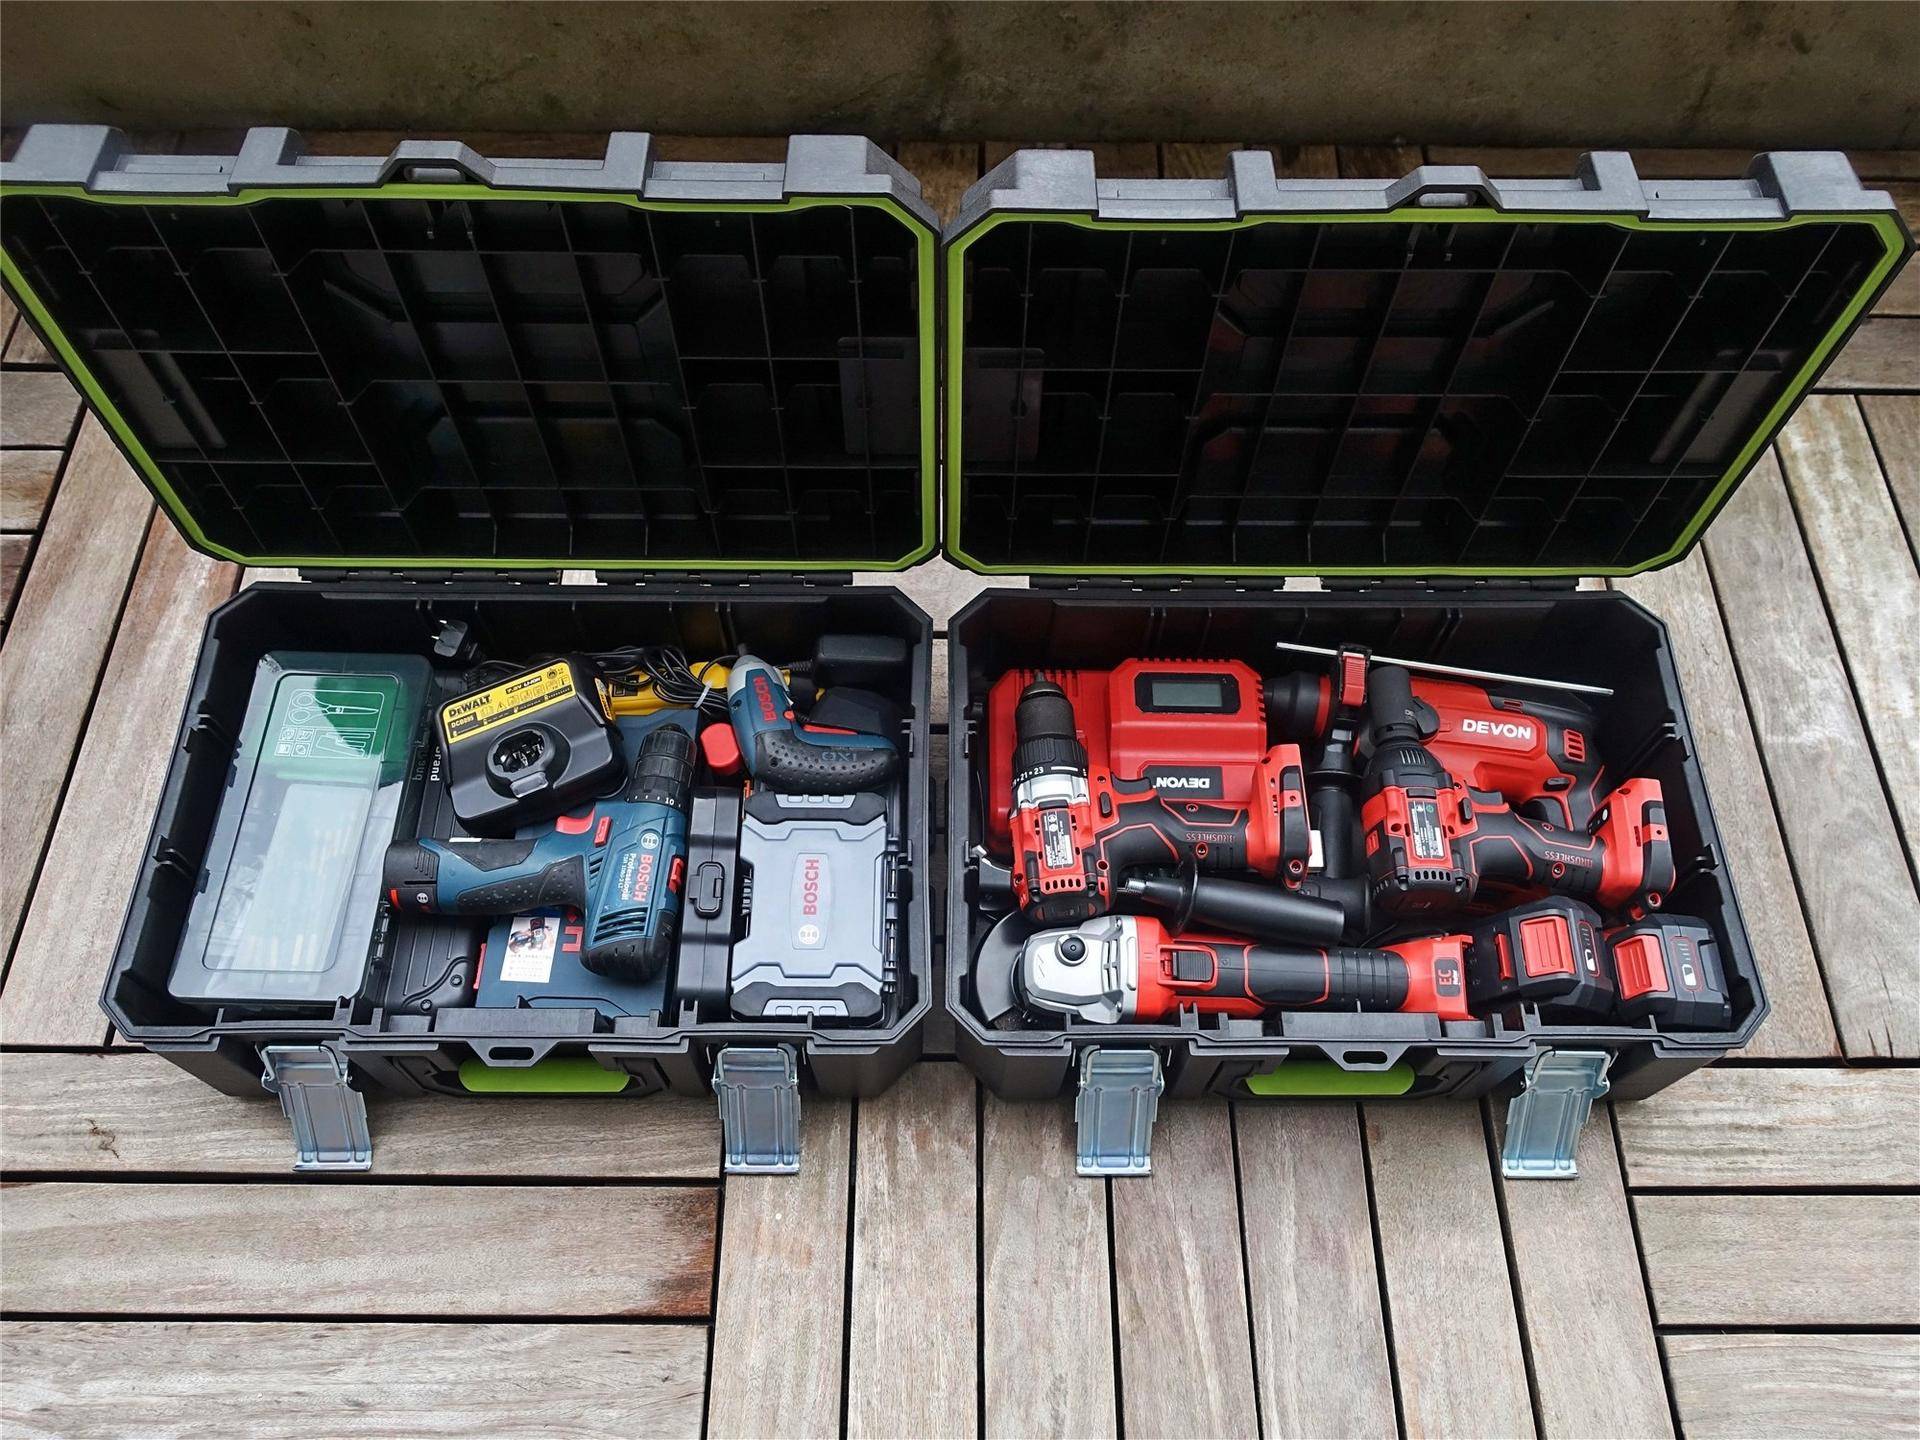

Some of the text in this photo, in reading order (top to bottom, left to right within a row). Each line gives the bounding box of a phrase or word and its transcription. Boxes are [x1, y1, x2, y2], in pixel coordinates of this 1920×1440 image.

[753, 675, 778, 722] BOSCH
[1462, 719, 1531, 740] DEVON
[1033, 766, 1044, 776] 23
[1155, 776, 1210, 789] DEVON
[664, 797, 675, 806] 10
[621, 853, 637, 901] Professional
[633, 854, 654, 902] BOSCH
[803, 859, 820, 915] BOSCH
[1438, 969, 1452, 985] EC
